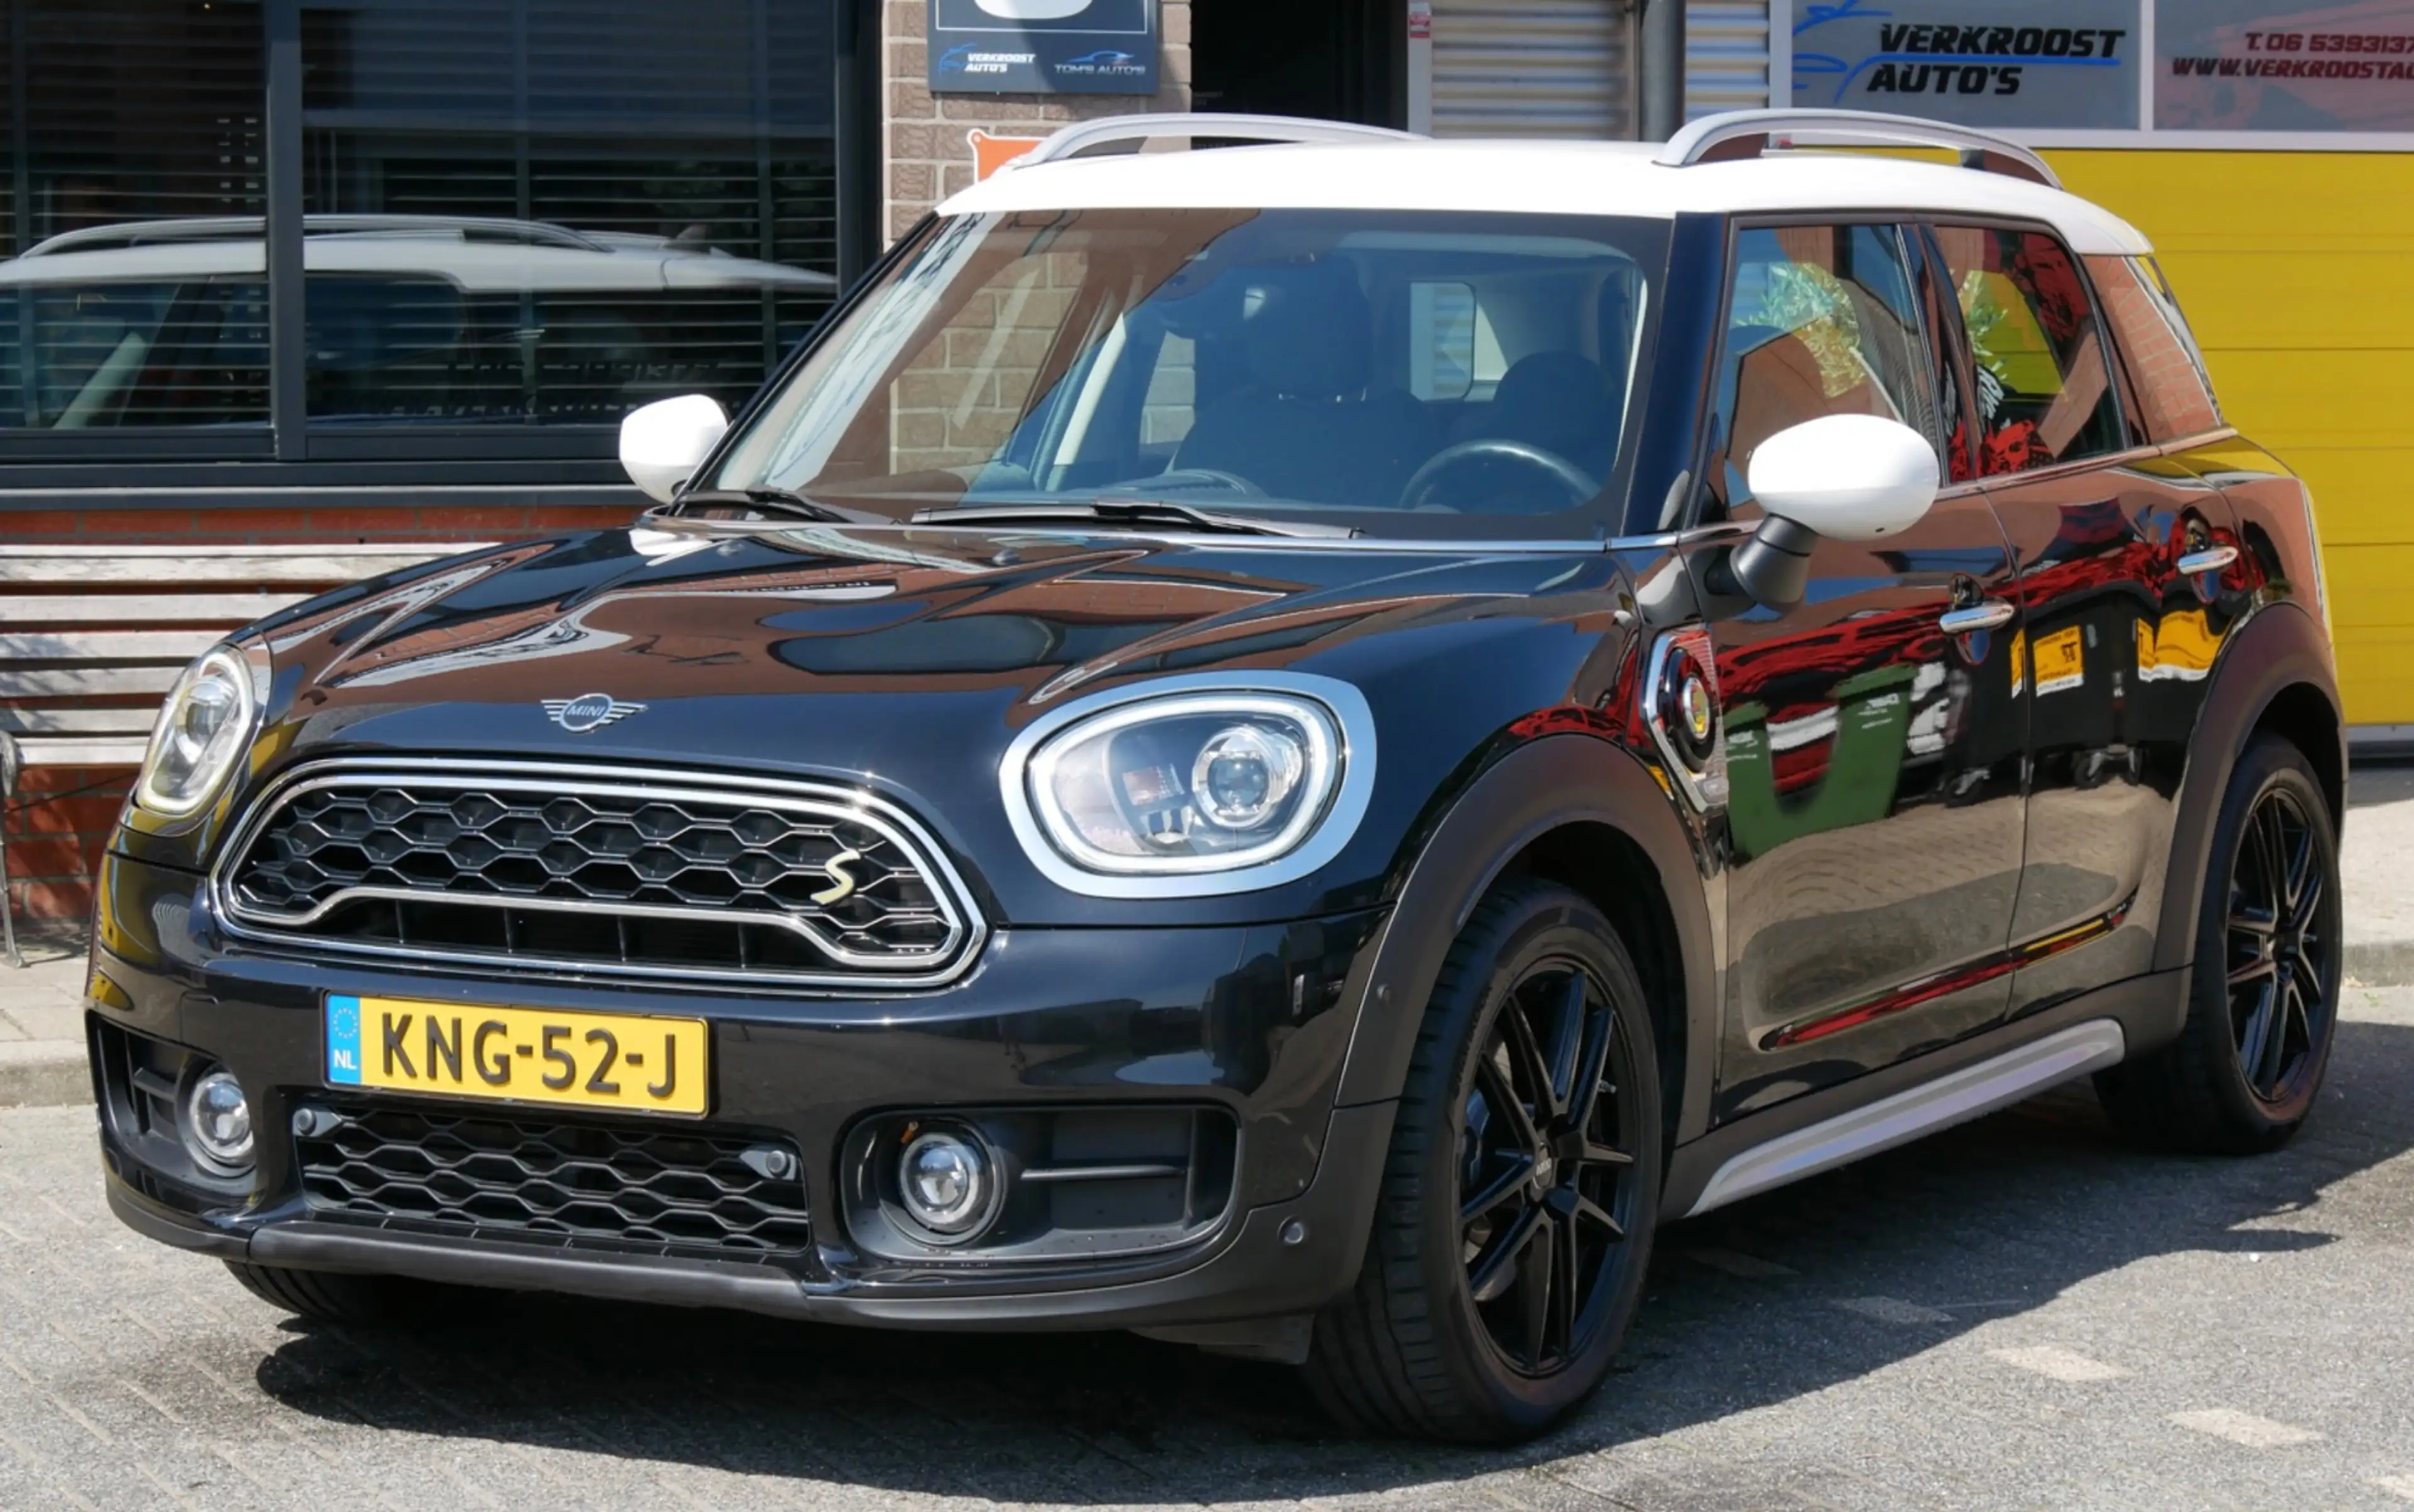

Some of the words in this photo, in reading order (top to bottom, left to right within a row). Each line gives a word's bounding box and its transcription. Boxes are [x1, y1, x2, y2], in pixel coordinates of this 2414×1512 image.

[1880, 23, 2125, 58] VERKROOST
[2265, 33, 2303, 52] 06
[967, 52, 1036, 63] VERKROOST
[964, 63, 1008, 72] AUTO'S
[1054, 63, 1094, 75] TOM'S
[1098, 64, 1146, 75] AUTO'S
[1866, 63, 2023, 95] AUTO'S
[567, 705, 605, 717] MINI
[810, 847, 861, 905] S
[333, 1049, 357, 1070] NL
[382, 1012, 676, 1098] KNG-52-J
